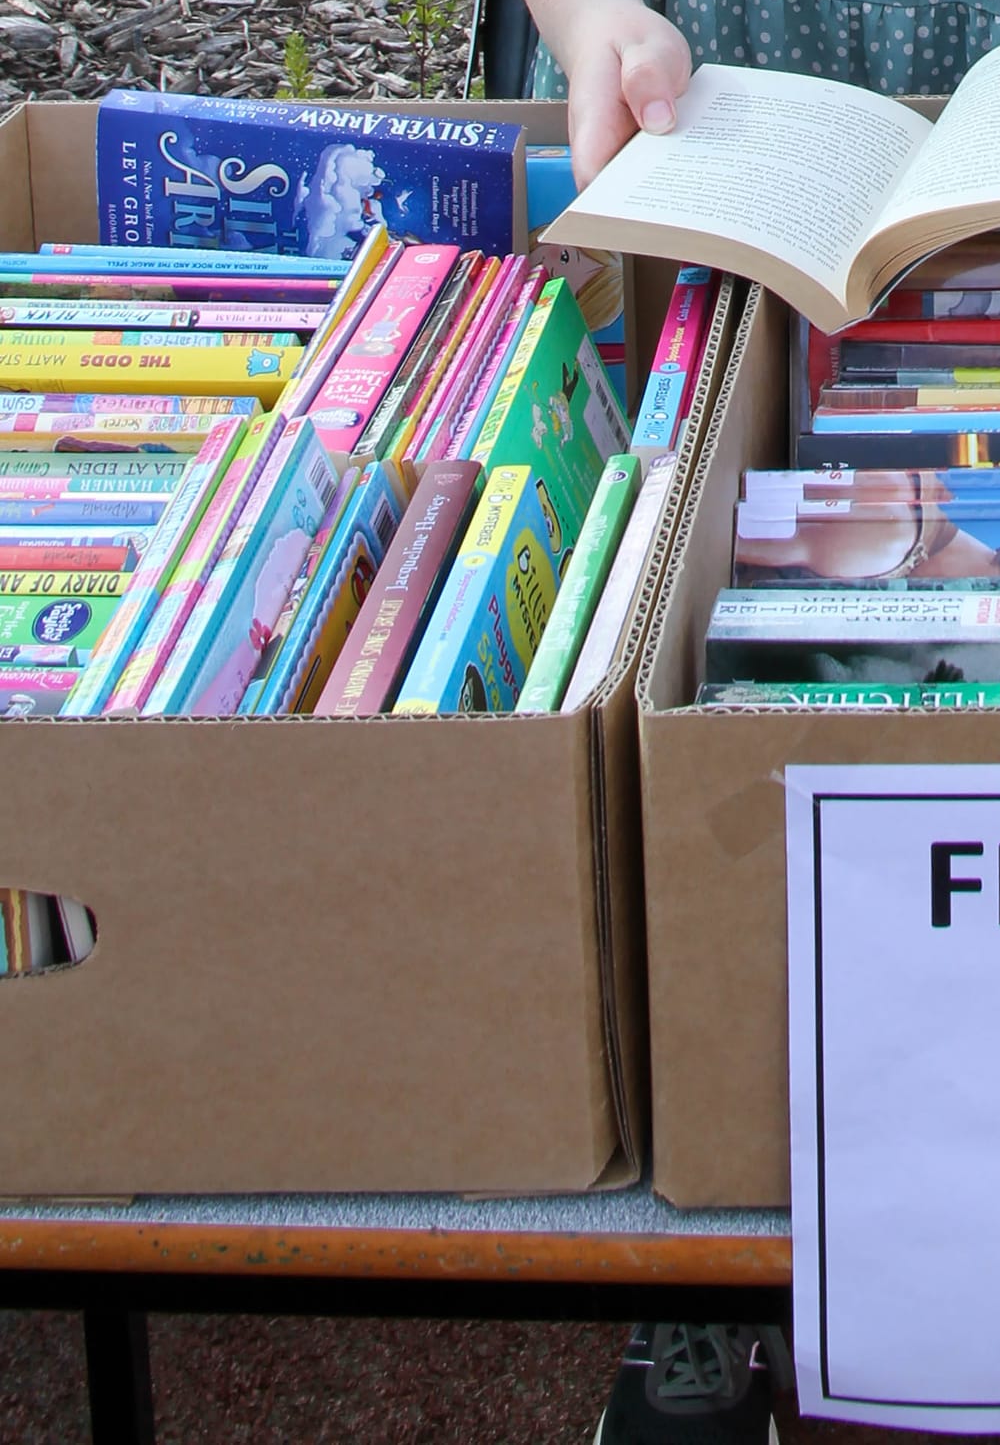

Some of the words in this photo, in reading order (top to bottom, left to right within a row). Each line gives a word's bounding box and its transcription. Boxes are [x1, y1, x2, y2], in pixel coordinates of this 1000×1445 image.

[200, 99, 289, 115] GROSSMAN
[288, 108, 387, 134] ARROW
[388, 117, 484, 146] SILVER
[122, 141, 137, 187] LEV
[123, 197, 139, 242] GRO
[129, 261, 155, 269] MAGIC
[215, 262, 232, 270] AND
[234, 262, 268, 271] MELINDA
[80, 354, 132, 367] ODDS
[141, 355, 171, 367] THE
[67, 463, 118, 476] EDEN
[80, 479, 152, 491] HARMER
[476, 505, 503, 547] MYSTERIES
[385, 534, 430, 592] Jacqueline
[413, 494, 451, 531] Harvey
[33, 576, 55, 592] OF
[66, 575, 120, 592] DIARY
